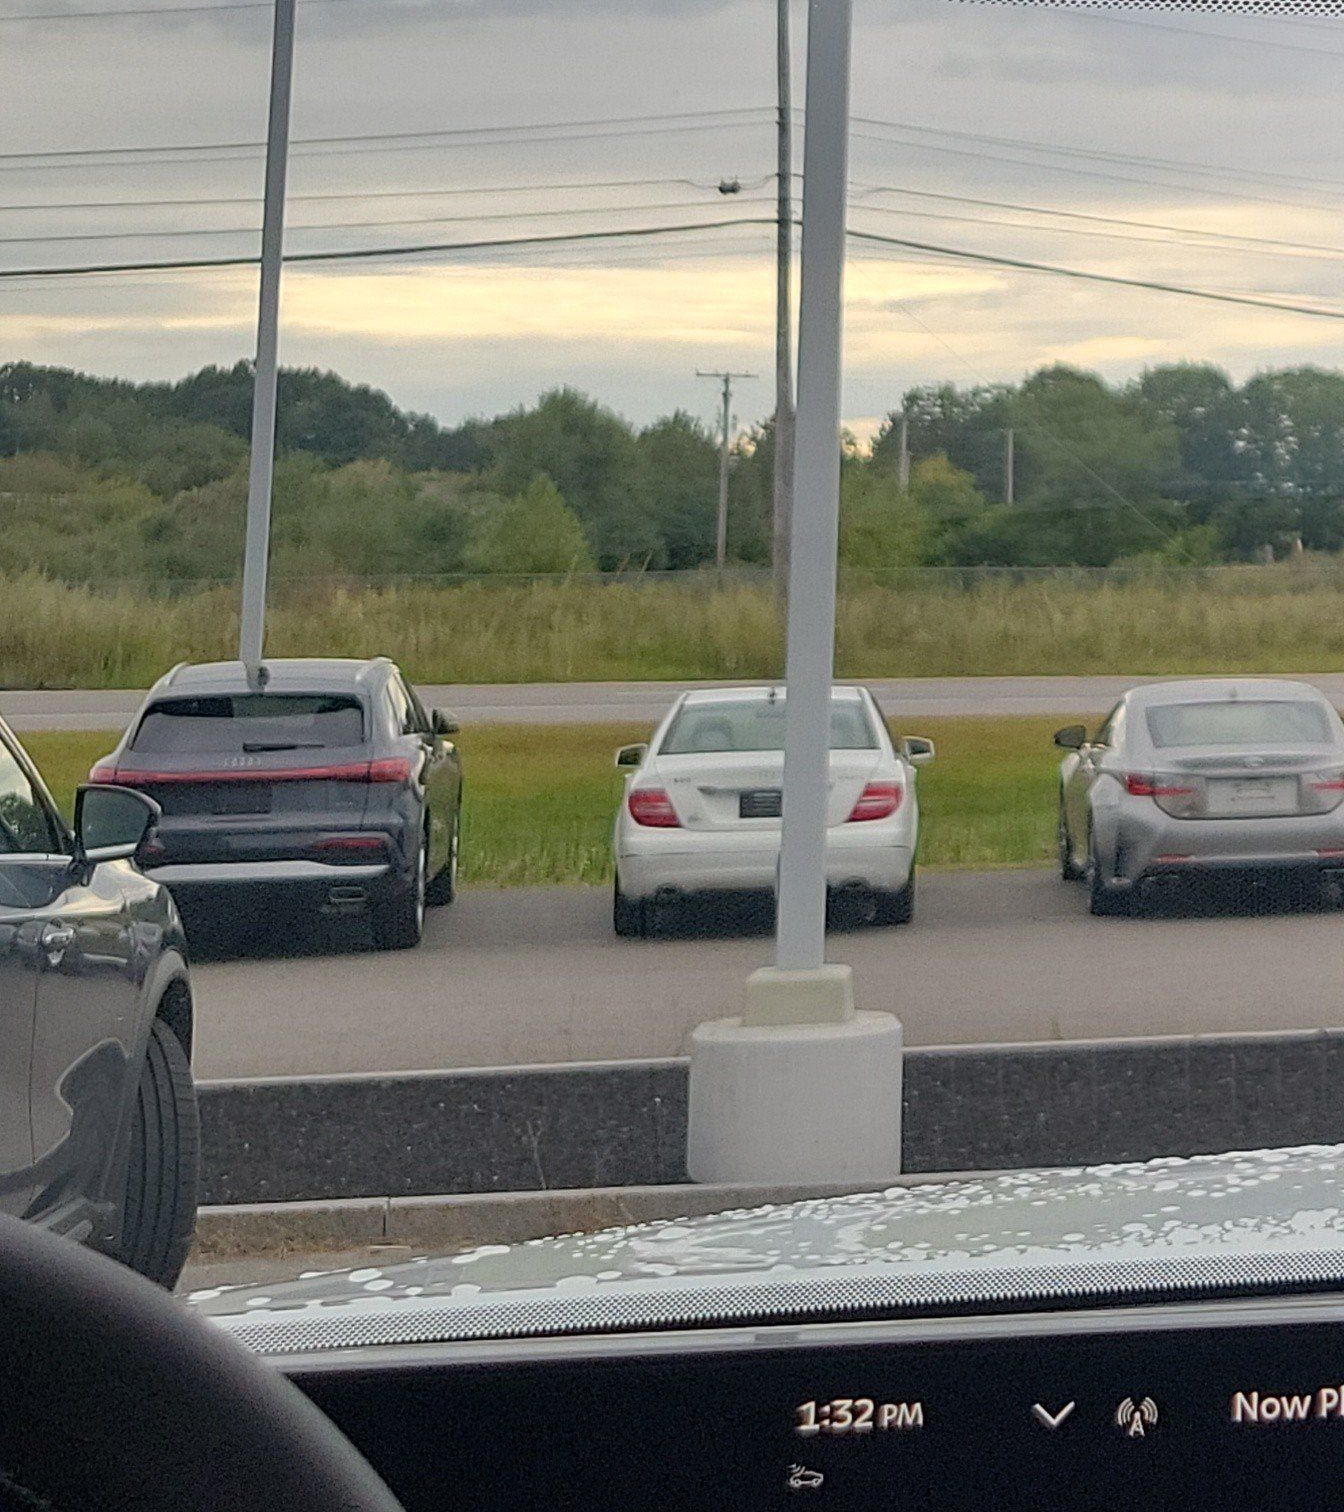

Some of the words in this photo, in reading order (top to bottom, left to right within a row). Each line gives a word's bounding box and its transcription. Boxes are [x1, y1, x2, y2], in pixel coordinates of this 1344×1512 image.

[796, 1398, 874, 1432] 1:32
[879, 1402, 924, 1430] PM
[1232, 1391, 1312, 1422] Now
